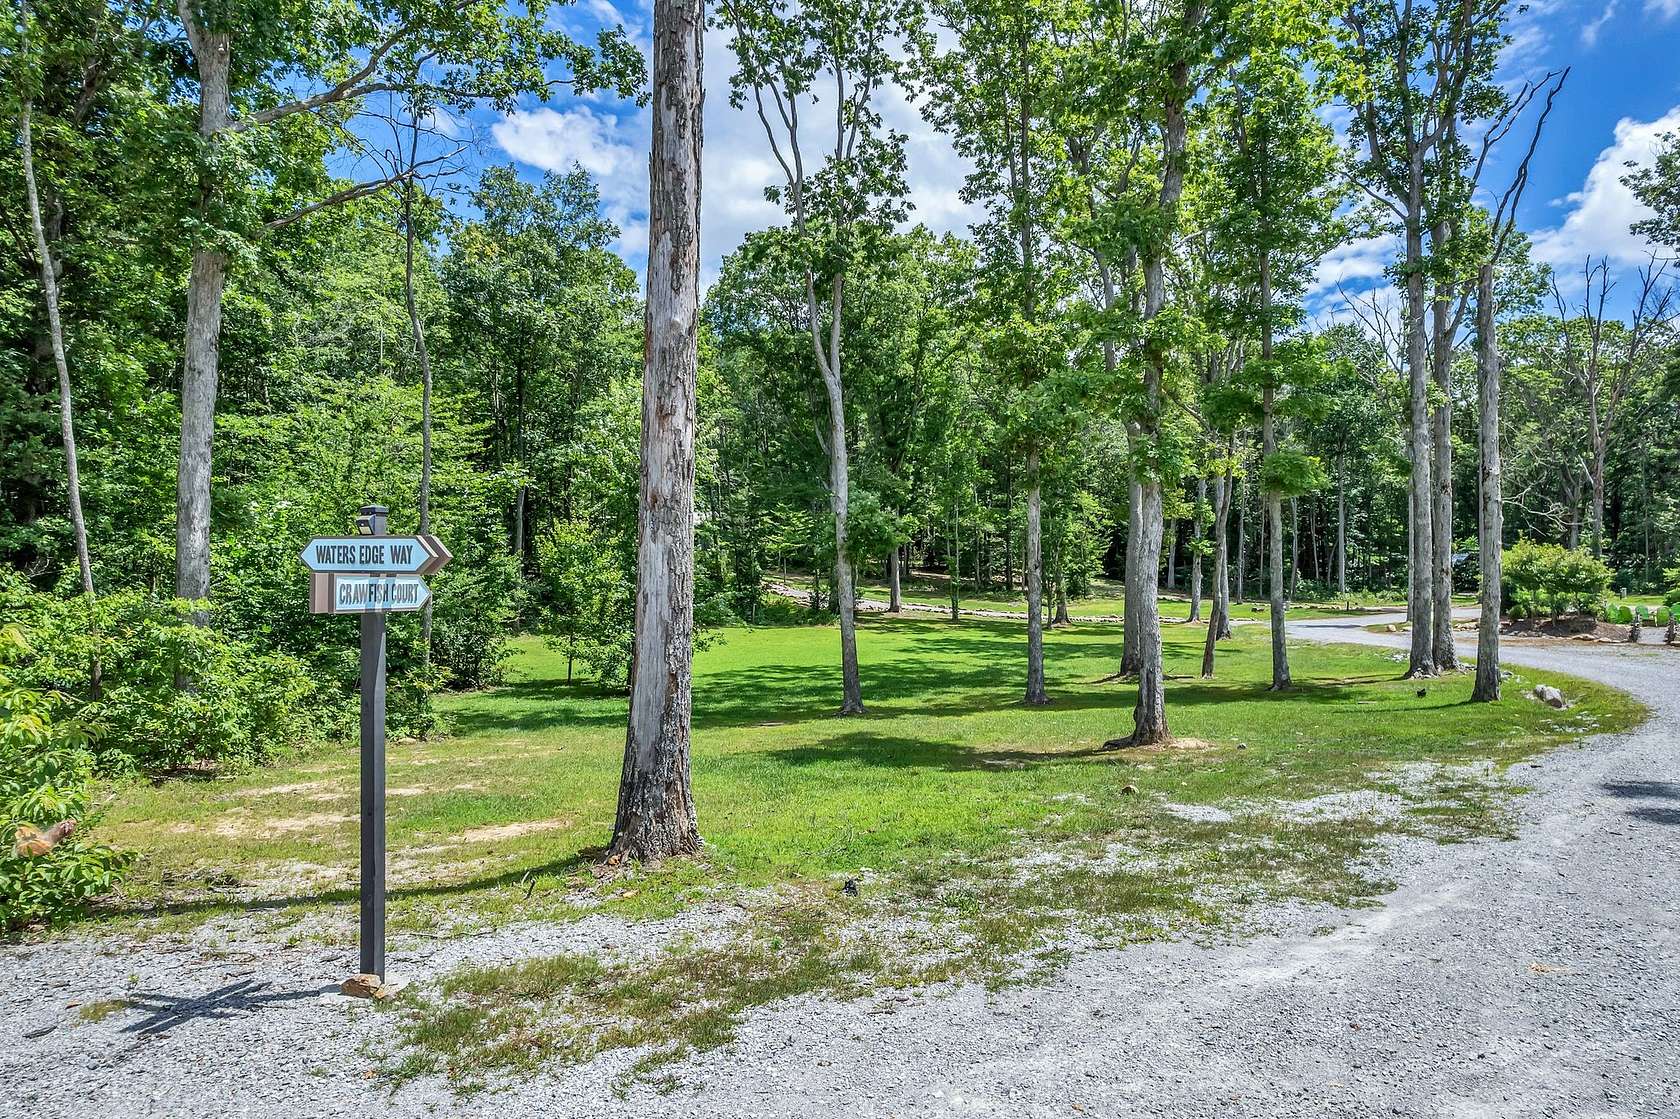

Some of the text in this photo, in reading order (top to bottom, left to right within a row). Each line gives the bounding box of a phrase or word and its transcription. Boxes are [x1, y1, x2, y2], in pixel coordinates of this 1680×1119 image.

[315, 545, 414, 565] WATERS EDGE WAY
[339, 583, 419, 605] CRAWFISH COURT
